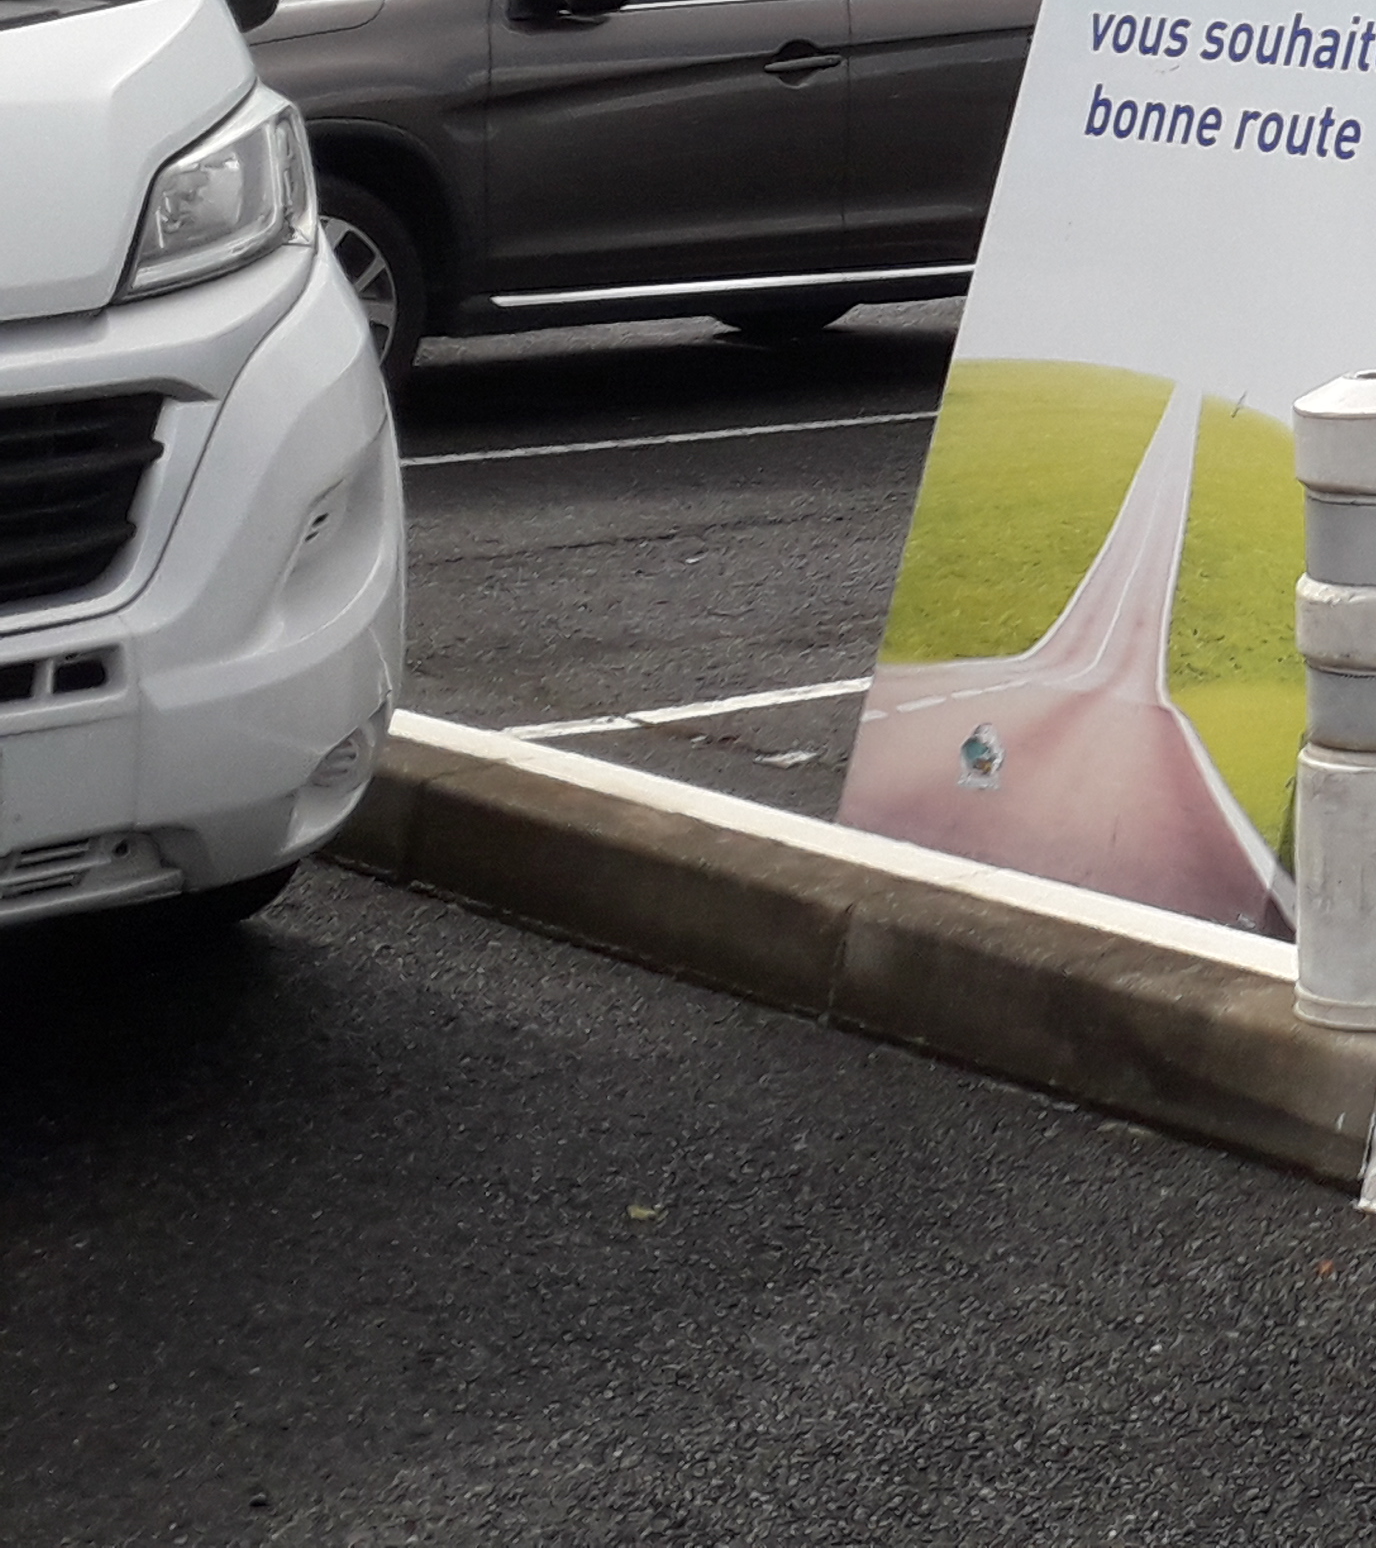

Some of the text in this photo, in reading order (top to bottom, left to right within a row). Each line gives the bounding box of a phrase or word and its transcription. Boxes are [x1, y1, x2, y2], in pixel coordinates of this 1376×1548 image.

[1090, 12, 1191, 60] vous
[1084, 83, 1363, 162] bonne route
